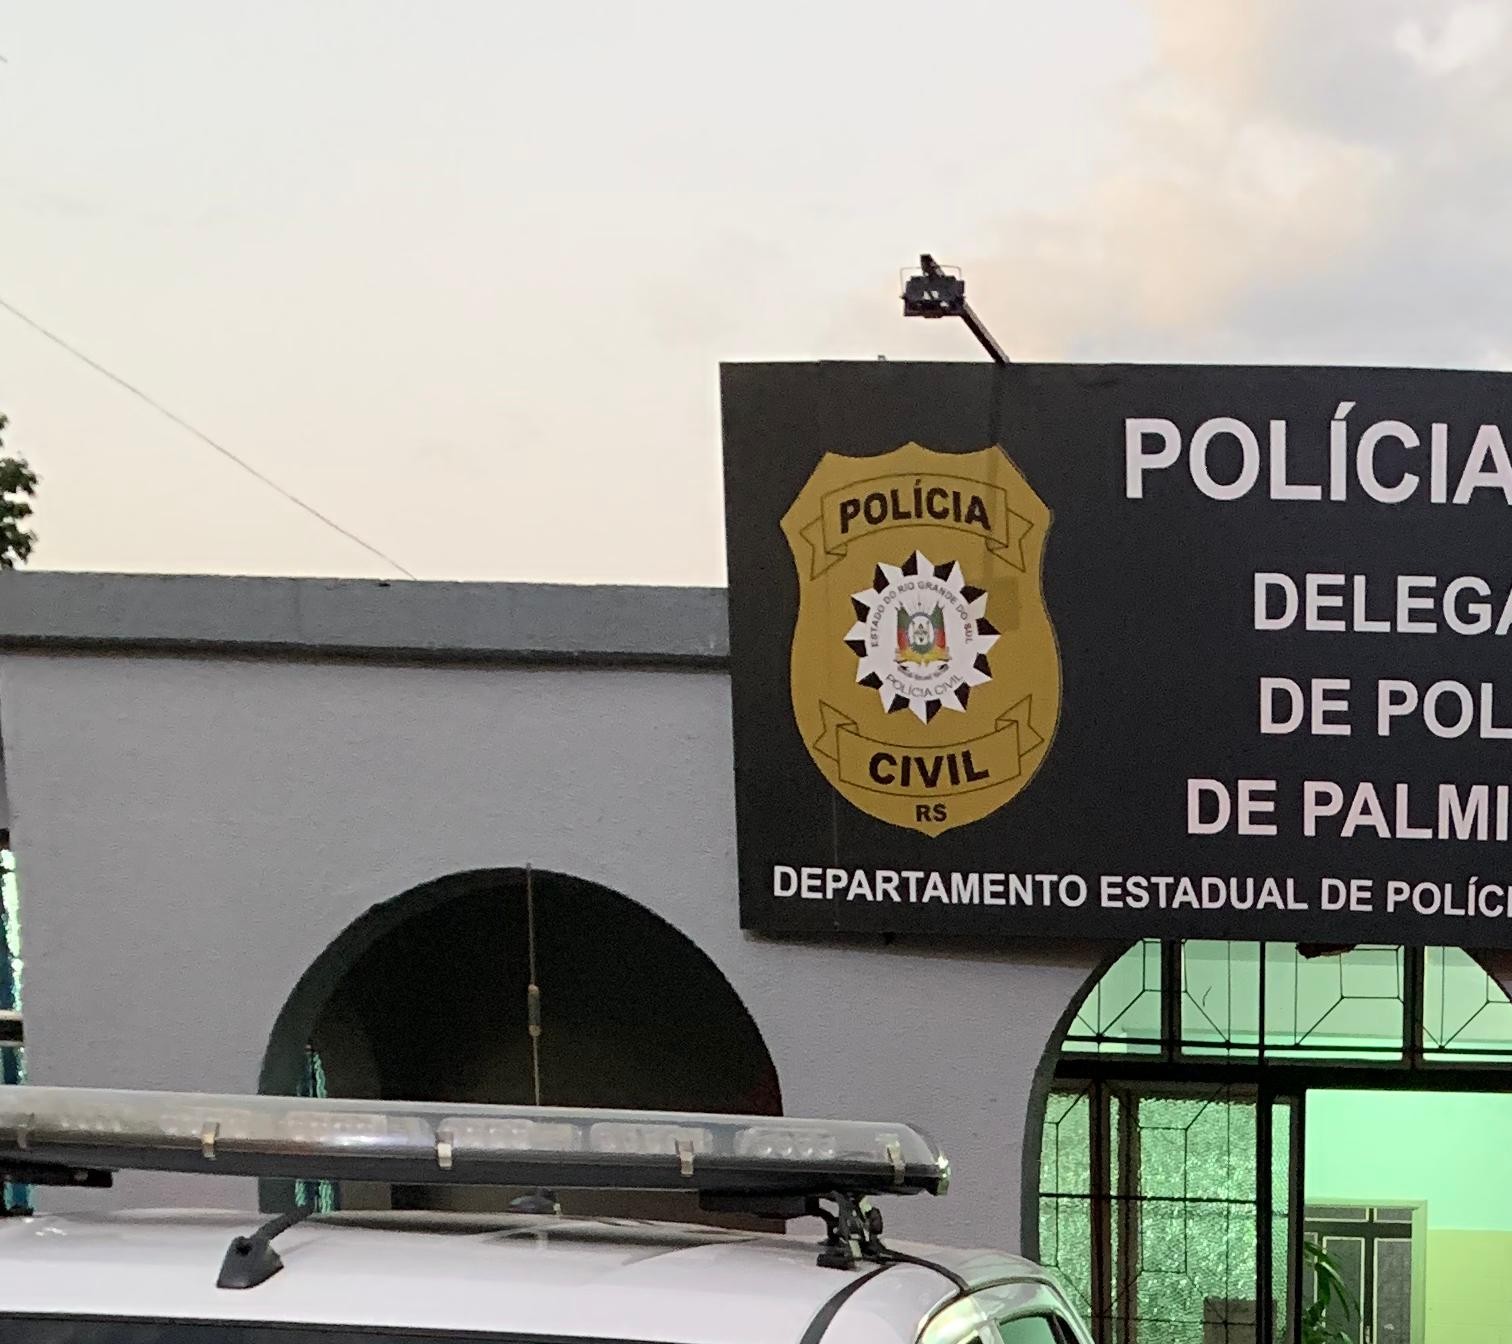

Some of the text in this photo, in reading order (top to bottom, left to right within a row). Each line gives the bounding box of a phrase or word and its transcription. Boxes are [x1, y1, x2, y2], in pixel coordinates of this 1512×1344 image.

[840, 478, 992, 535] POLÍCIA
[870, 580, 974, 648] ESTADO DO RIO GRANDE DO SUL
[934, 673, 964, 696] CIVIL
[1260, 677, 1352, 736] DE
[868, 750, 990, 788] CIVIL
[915, 803, 948, 823] RS
[1187, 777, 1278, 837] DE
[773, 865, 1088, 907] DEPARTAMENTO
[1100, 875, 1309, 912] ESTADUAL
[1321, 877, 1373, 915] DE
